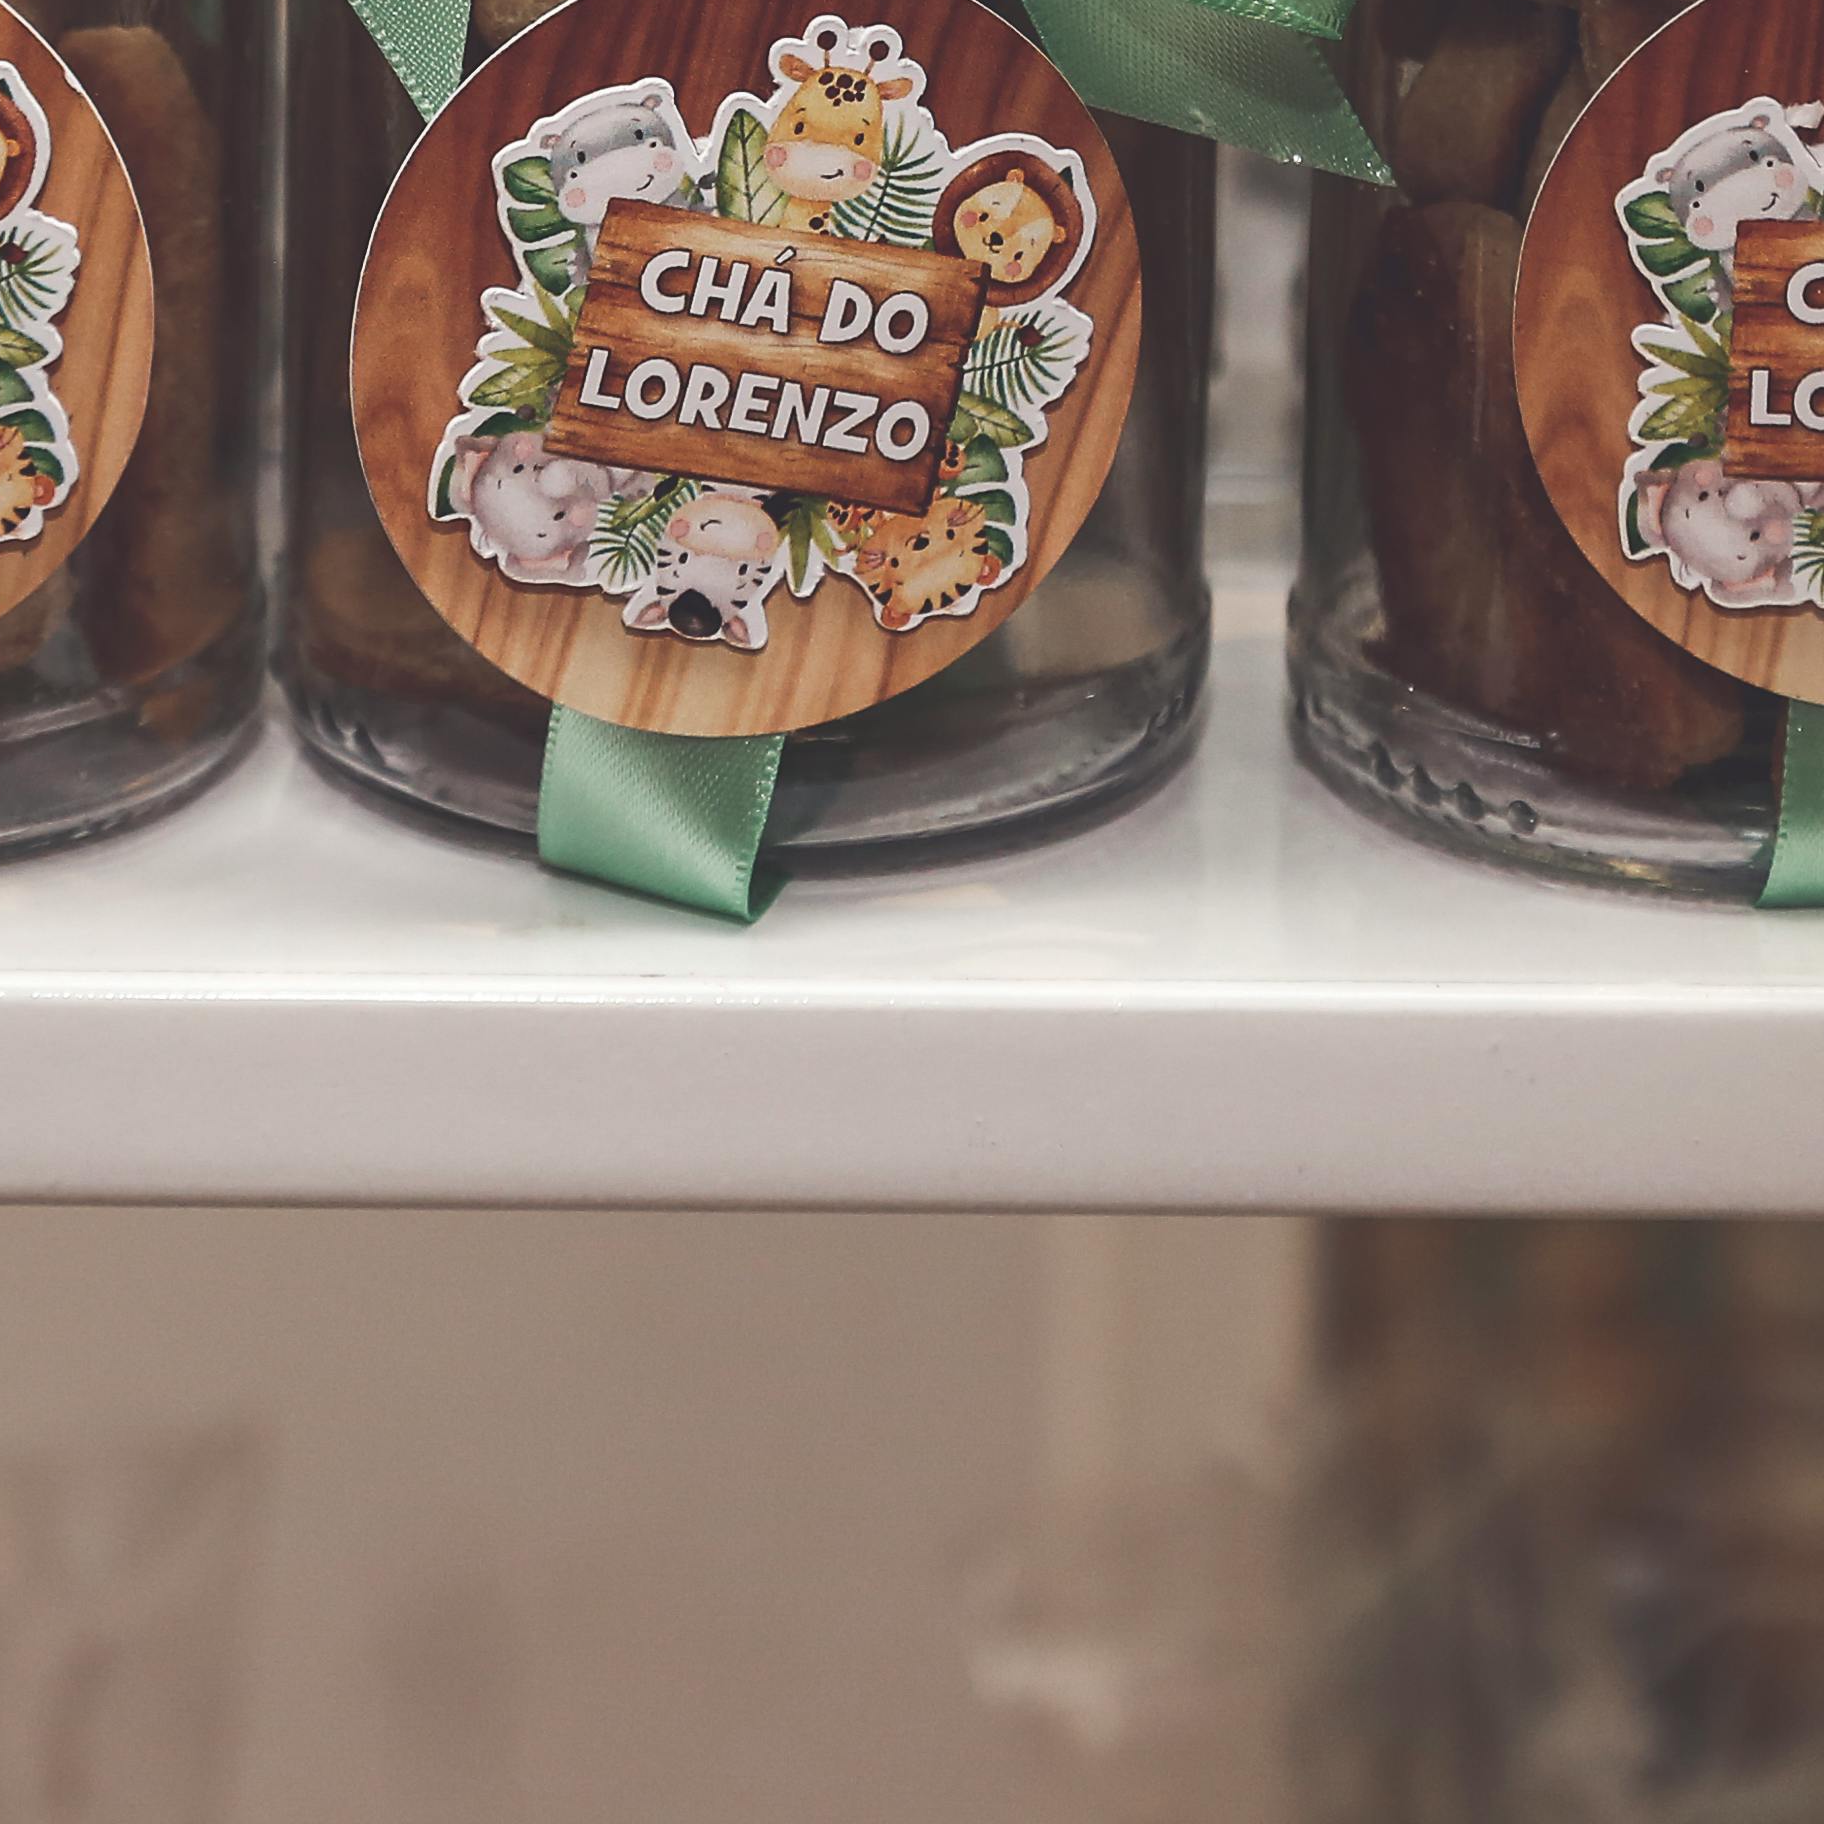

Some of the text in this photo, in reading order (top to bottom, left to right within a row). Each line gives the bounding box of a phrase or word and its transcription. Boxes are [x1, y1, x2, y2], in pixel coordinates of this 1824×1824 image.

[639, 246, 929, 354] CHÁ DO
[578, 348, 931, 462] LORENZO
